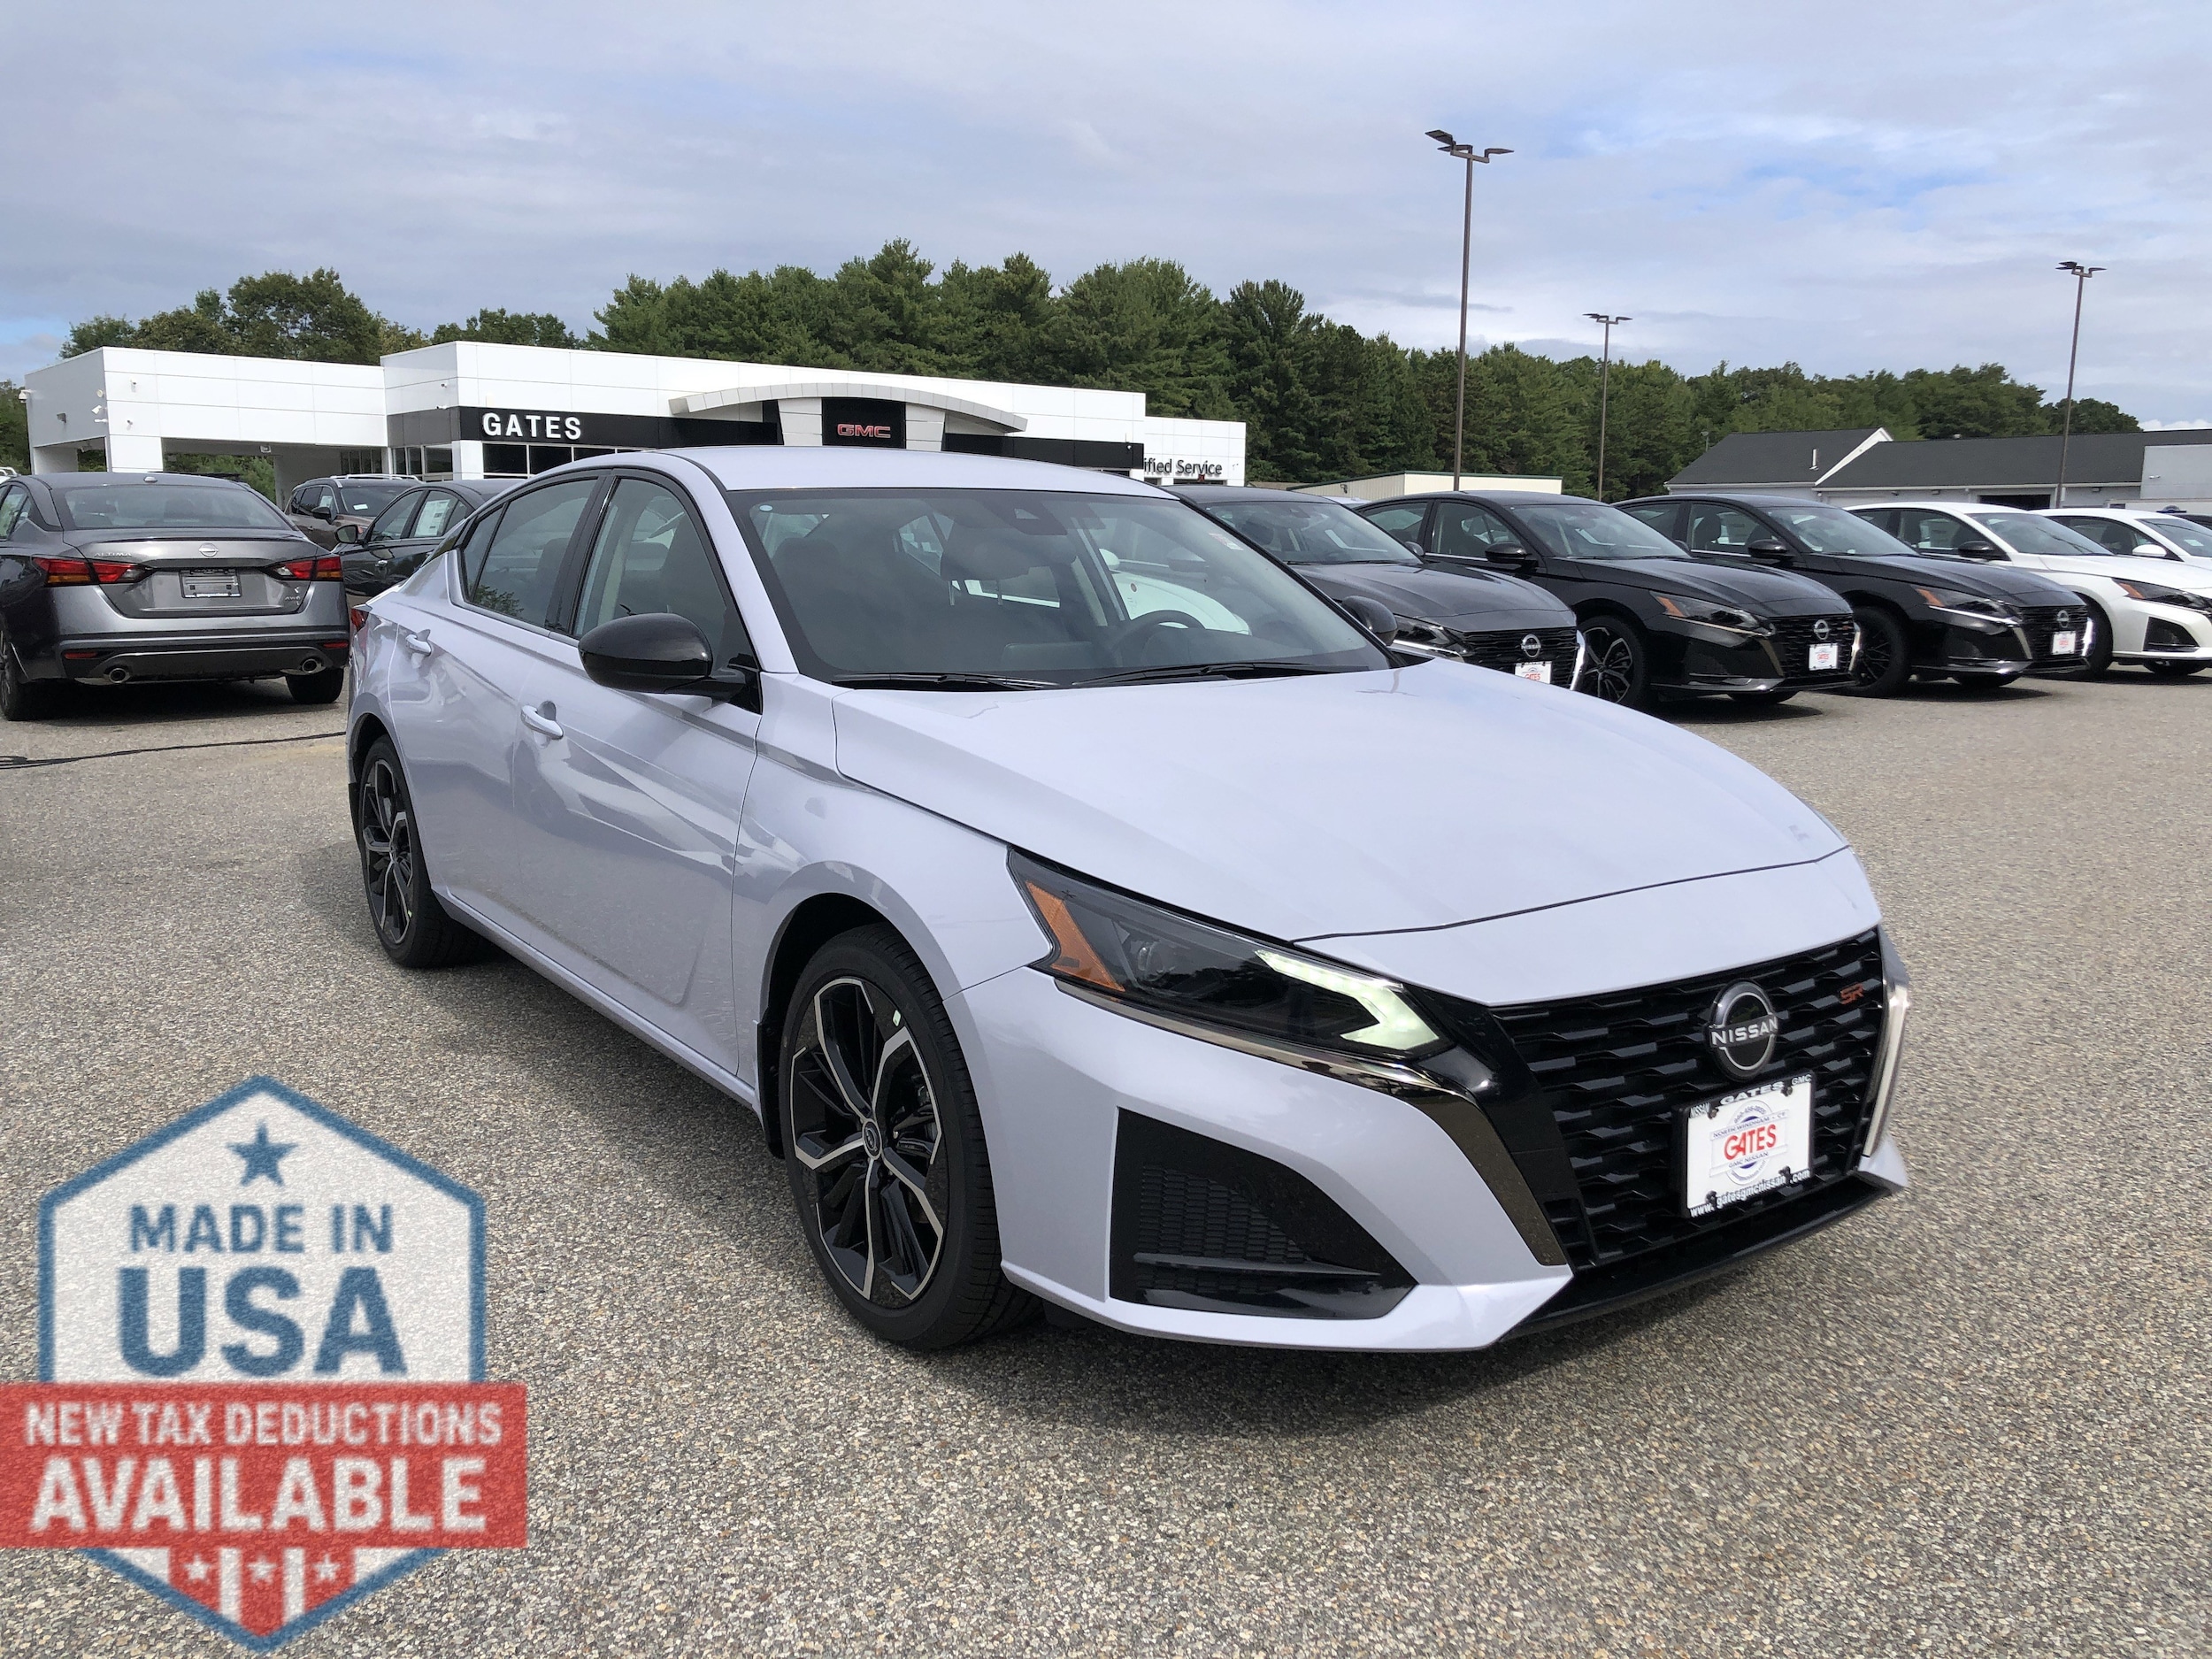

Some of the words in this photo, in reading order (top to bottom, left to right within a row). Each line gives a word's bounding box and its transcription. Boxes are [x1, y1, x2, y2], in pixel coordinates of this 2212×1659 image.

[482, 412, 581, 440] GATES
[837, 423, 891, 439] GMC
[1175, 459, 1223, 476] Service
[1839, 982, 1865, 1006] SR
[1710, 1015, 1778, 1047] NISSAN
[1720, 1081, 1785, 1105] GATES
[1791, 1073, 1812, 1087] GMC
[1713, 1125, 1736, 1138] NORTH
[1737, 1116, 1770, 1133] WINDHAM
[1724, 1124, 1777, 1160] GATES
[1728, 1158, 1743, 1169] GMC
[1744, 1151, 1769, 1164] NISSAN
